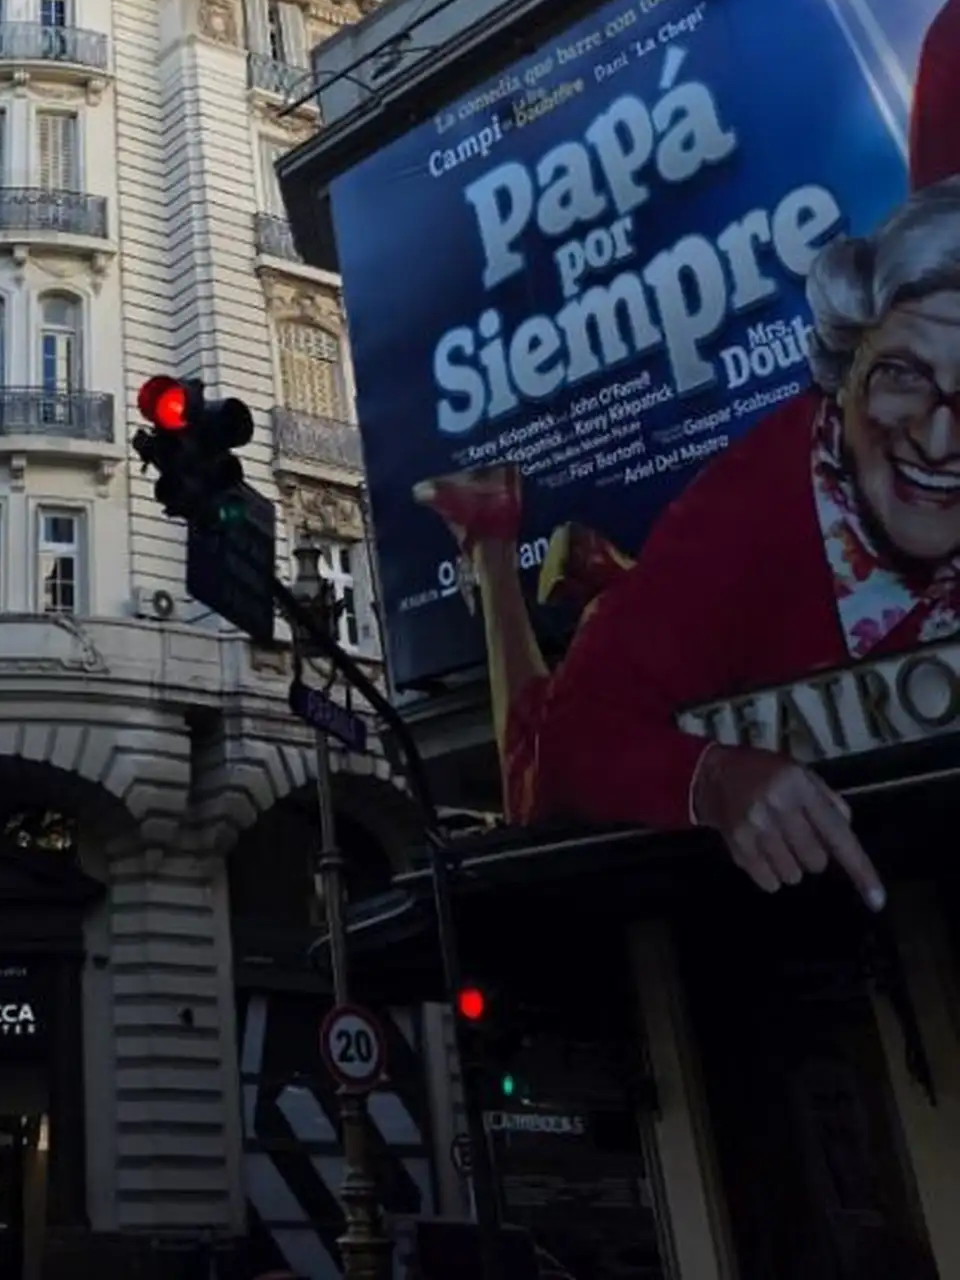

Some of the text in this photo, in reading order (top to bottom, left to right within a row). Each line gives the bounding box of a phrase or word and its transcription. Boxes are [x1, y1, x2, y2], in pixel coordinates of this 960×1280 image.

[457, 74, 521, 120] comedia
[524, 55, 555, 87] que
[556, 31, 603, 65] barre
[604, 7, 638, 38] con
[428, 113, 505, 178] Campi
[465, 45, 737, 291] Papá
[555, 217, 634, 298] por
[433, 184, 841, 434] Siempre
[732, 380, 801, 418] Scabuzzo
[677, 654, 958, 758] TEATRO
[336, 1029, 373, 1064] 20
